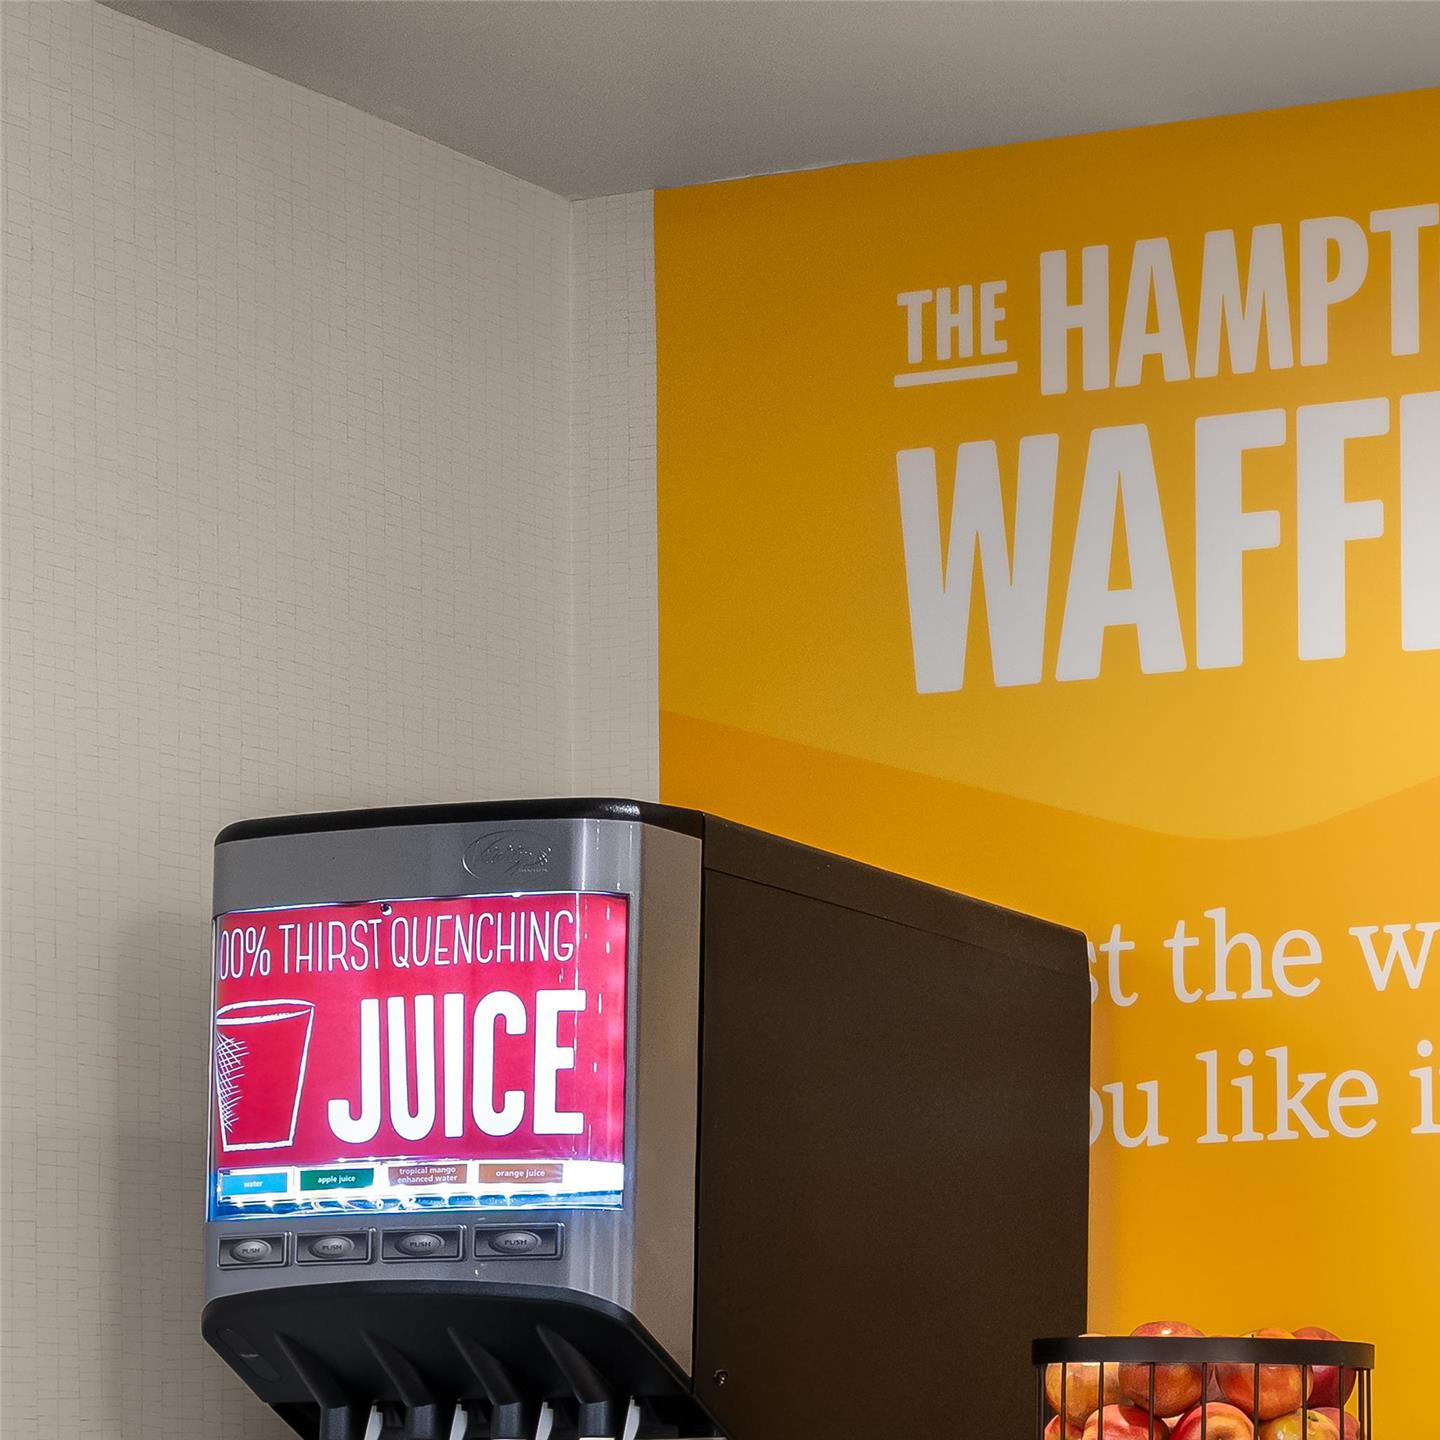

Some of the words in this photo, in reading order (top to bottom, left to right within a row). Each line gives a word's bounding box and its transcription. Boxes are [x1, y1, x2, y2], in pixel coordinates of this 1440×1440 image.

[897, 280, 1008, 364] THE
[279, 918, 382, 974] THIRST
[391, 909, 575, 969] QUENCHING
[1163, 907, 1322, 1004] the
[327, 989, 587, 1143] JUICE
[1196, 1046, 1379, 1144] like
[317, 1176, 338, 1184] apple
[338, 1175, 356, 1183] juice
[397, 1174, 434, 1183] enhanced
[435, 1174, 458, 1182] water
[399, 1167, 428, 1175] tropical
[429, 1166, 456, 1174] mango
[496, 1170, 524, 1178] orange
[525, 1169, 545, 1178] juice
